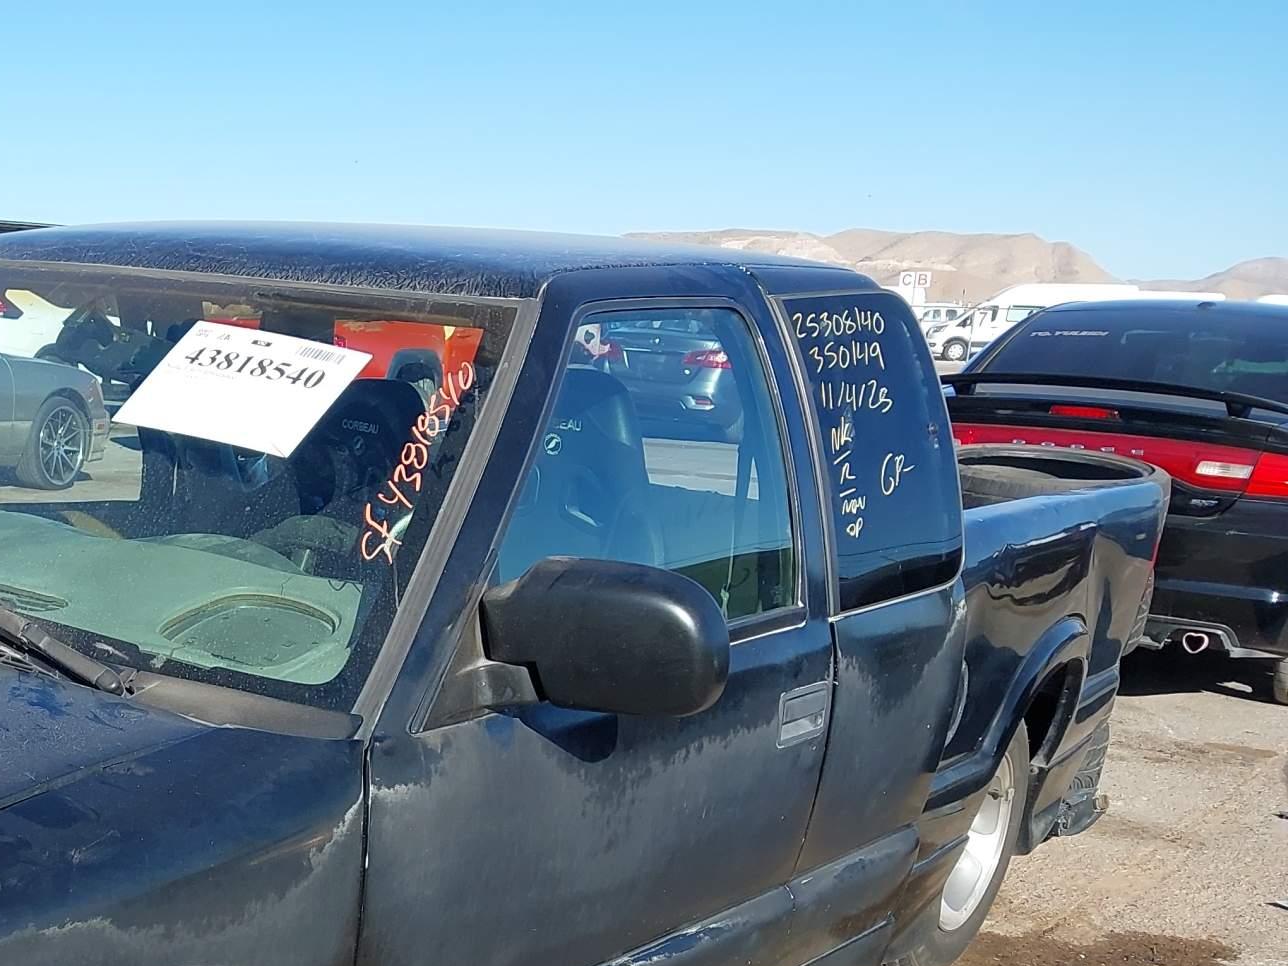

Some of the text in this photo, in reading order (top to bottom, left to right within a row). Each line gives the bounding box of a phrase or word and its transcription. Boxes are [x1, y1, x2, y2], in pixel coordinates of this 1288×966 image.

[902, 273, 913, 286] C
[917, 273, 928, 286] B
[792, 306, 885, 338] 25308140
[184, 347, 326, 389] 43818540
[809, 340, 885, 374] 350149
[342, 418, 380, 435] CORBEAU
